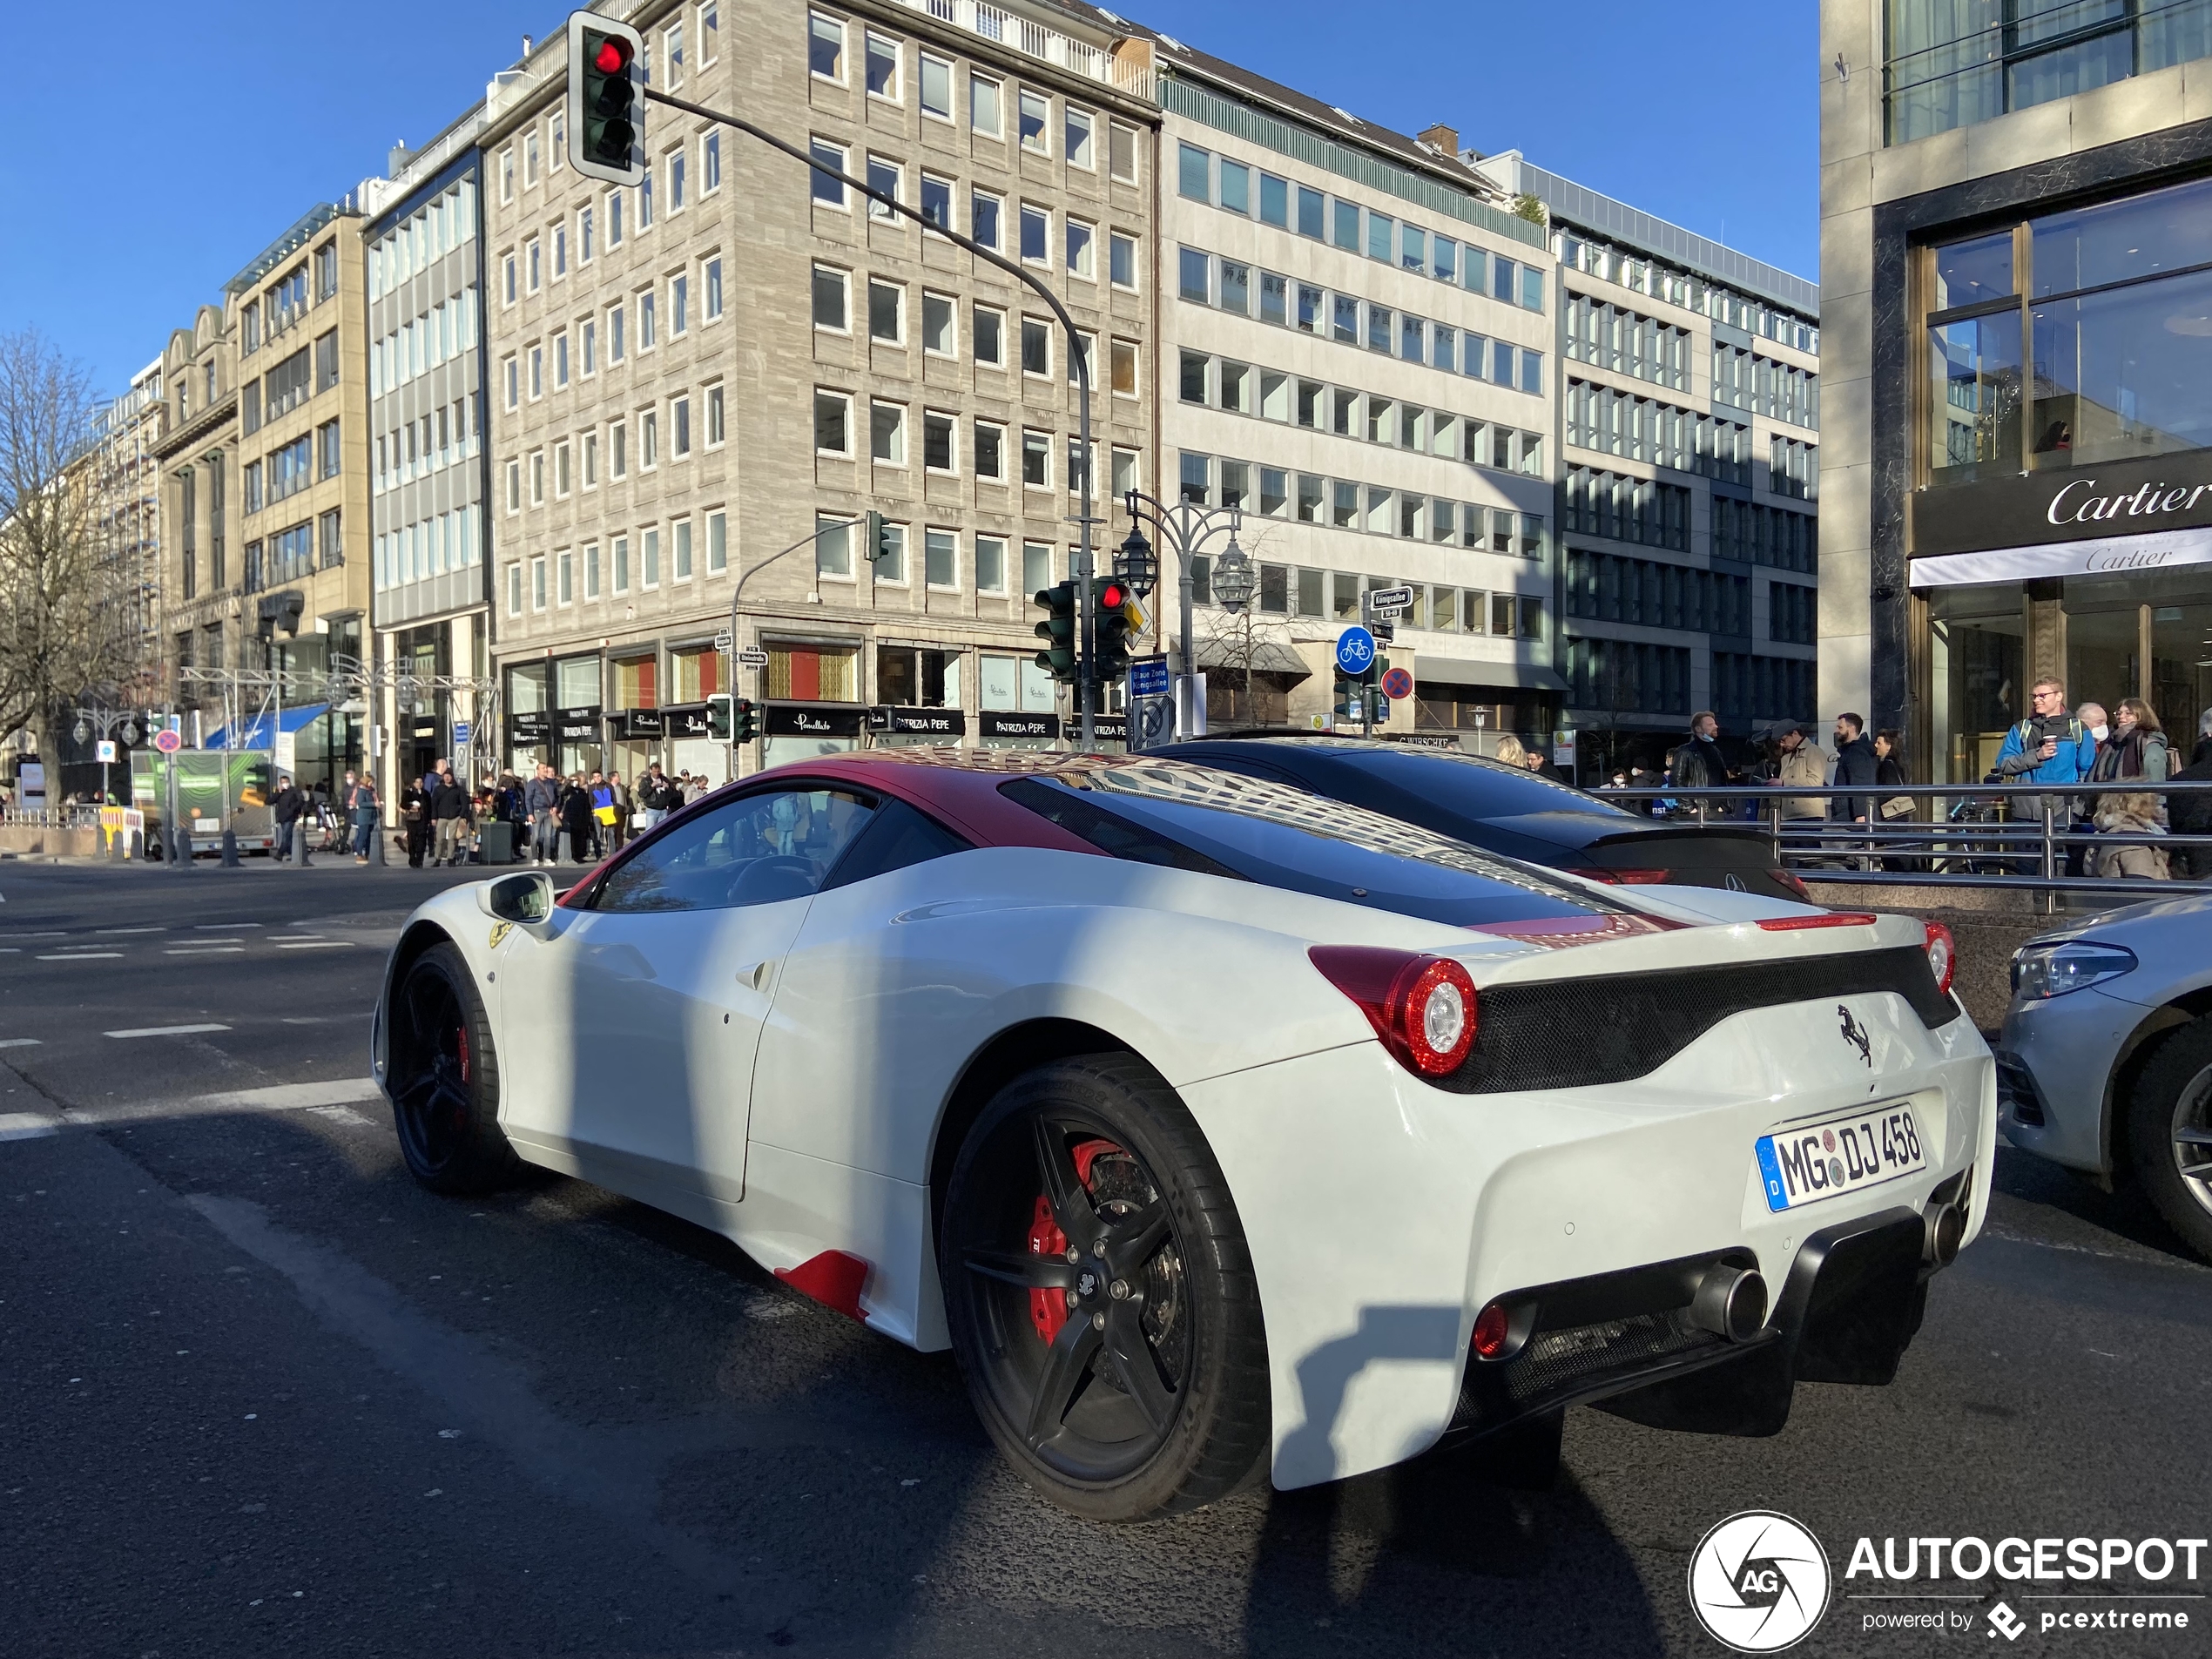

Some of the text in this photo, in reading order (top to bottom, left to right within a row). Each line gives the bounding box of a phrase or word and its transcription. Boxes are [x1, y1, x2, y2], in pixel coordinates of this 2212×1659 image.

[2047, 479, 2212, 525] Cartier
[2086, 547, 2173, 571] Cartier
[1134, 669, 1166, 679] Blaue Zone
[1134, 679, 1167, 690] Königsallee
[793, 712, 831, 731] Pomellato
[896, 717, 949, 730] PATRIZIA PEPE
[995, 720, 1046, 733] PATRIZIA PEPE
[1779, 1111, 1921, 1197] MG DJ 458
[1770, 1180, 1780, 1196] D
